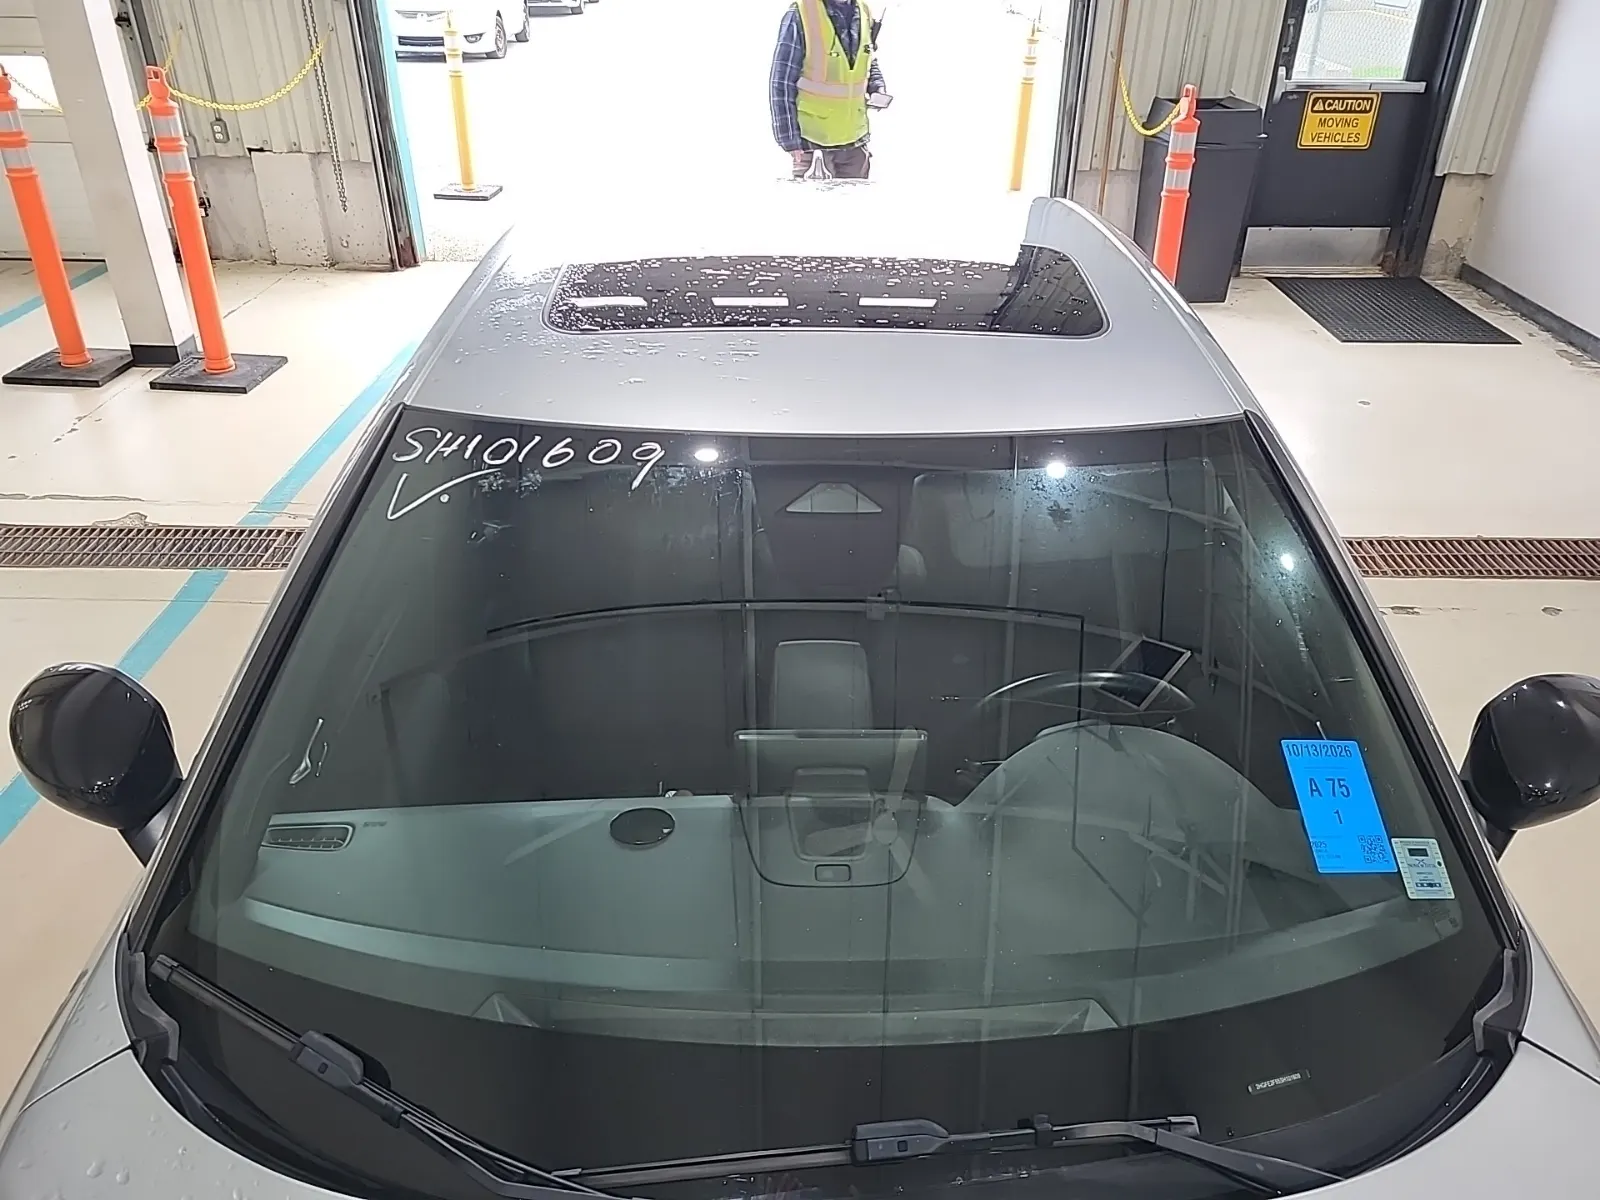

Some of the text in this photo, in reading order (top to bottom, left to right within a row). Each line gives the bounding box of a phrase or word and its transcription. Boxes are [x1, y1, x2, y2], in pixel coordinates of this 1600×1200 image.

[1324, 99, 1372, 111] CAUTION
[1317, 117, 1359, 128] MOVING
[1310, 132, 1361, 143] VEHICLES
[392, 427, 666, 491] SH101609
[1285, 743, 1353, 758] 10/13/2026
[1309, 777, 1351, 798] A 75
[1333, 809, 1343, 825] 1
